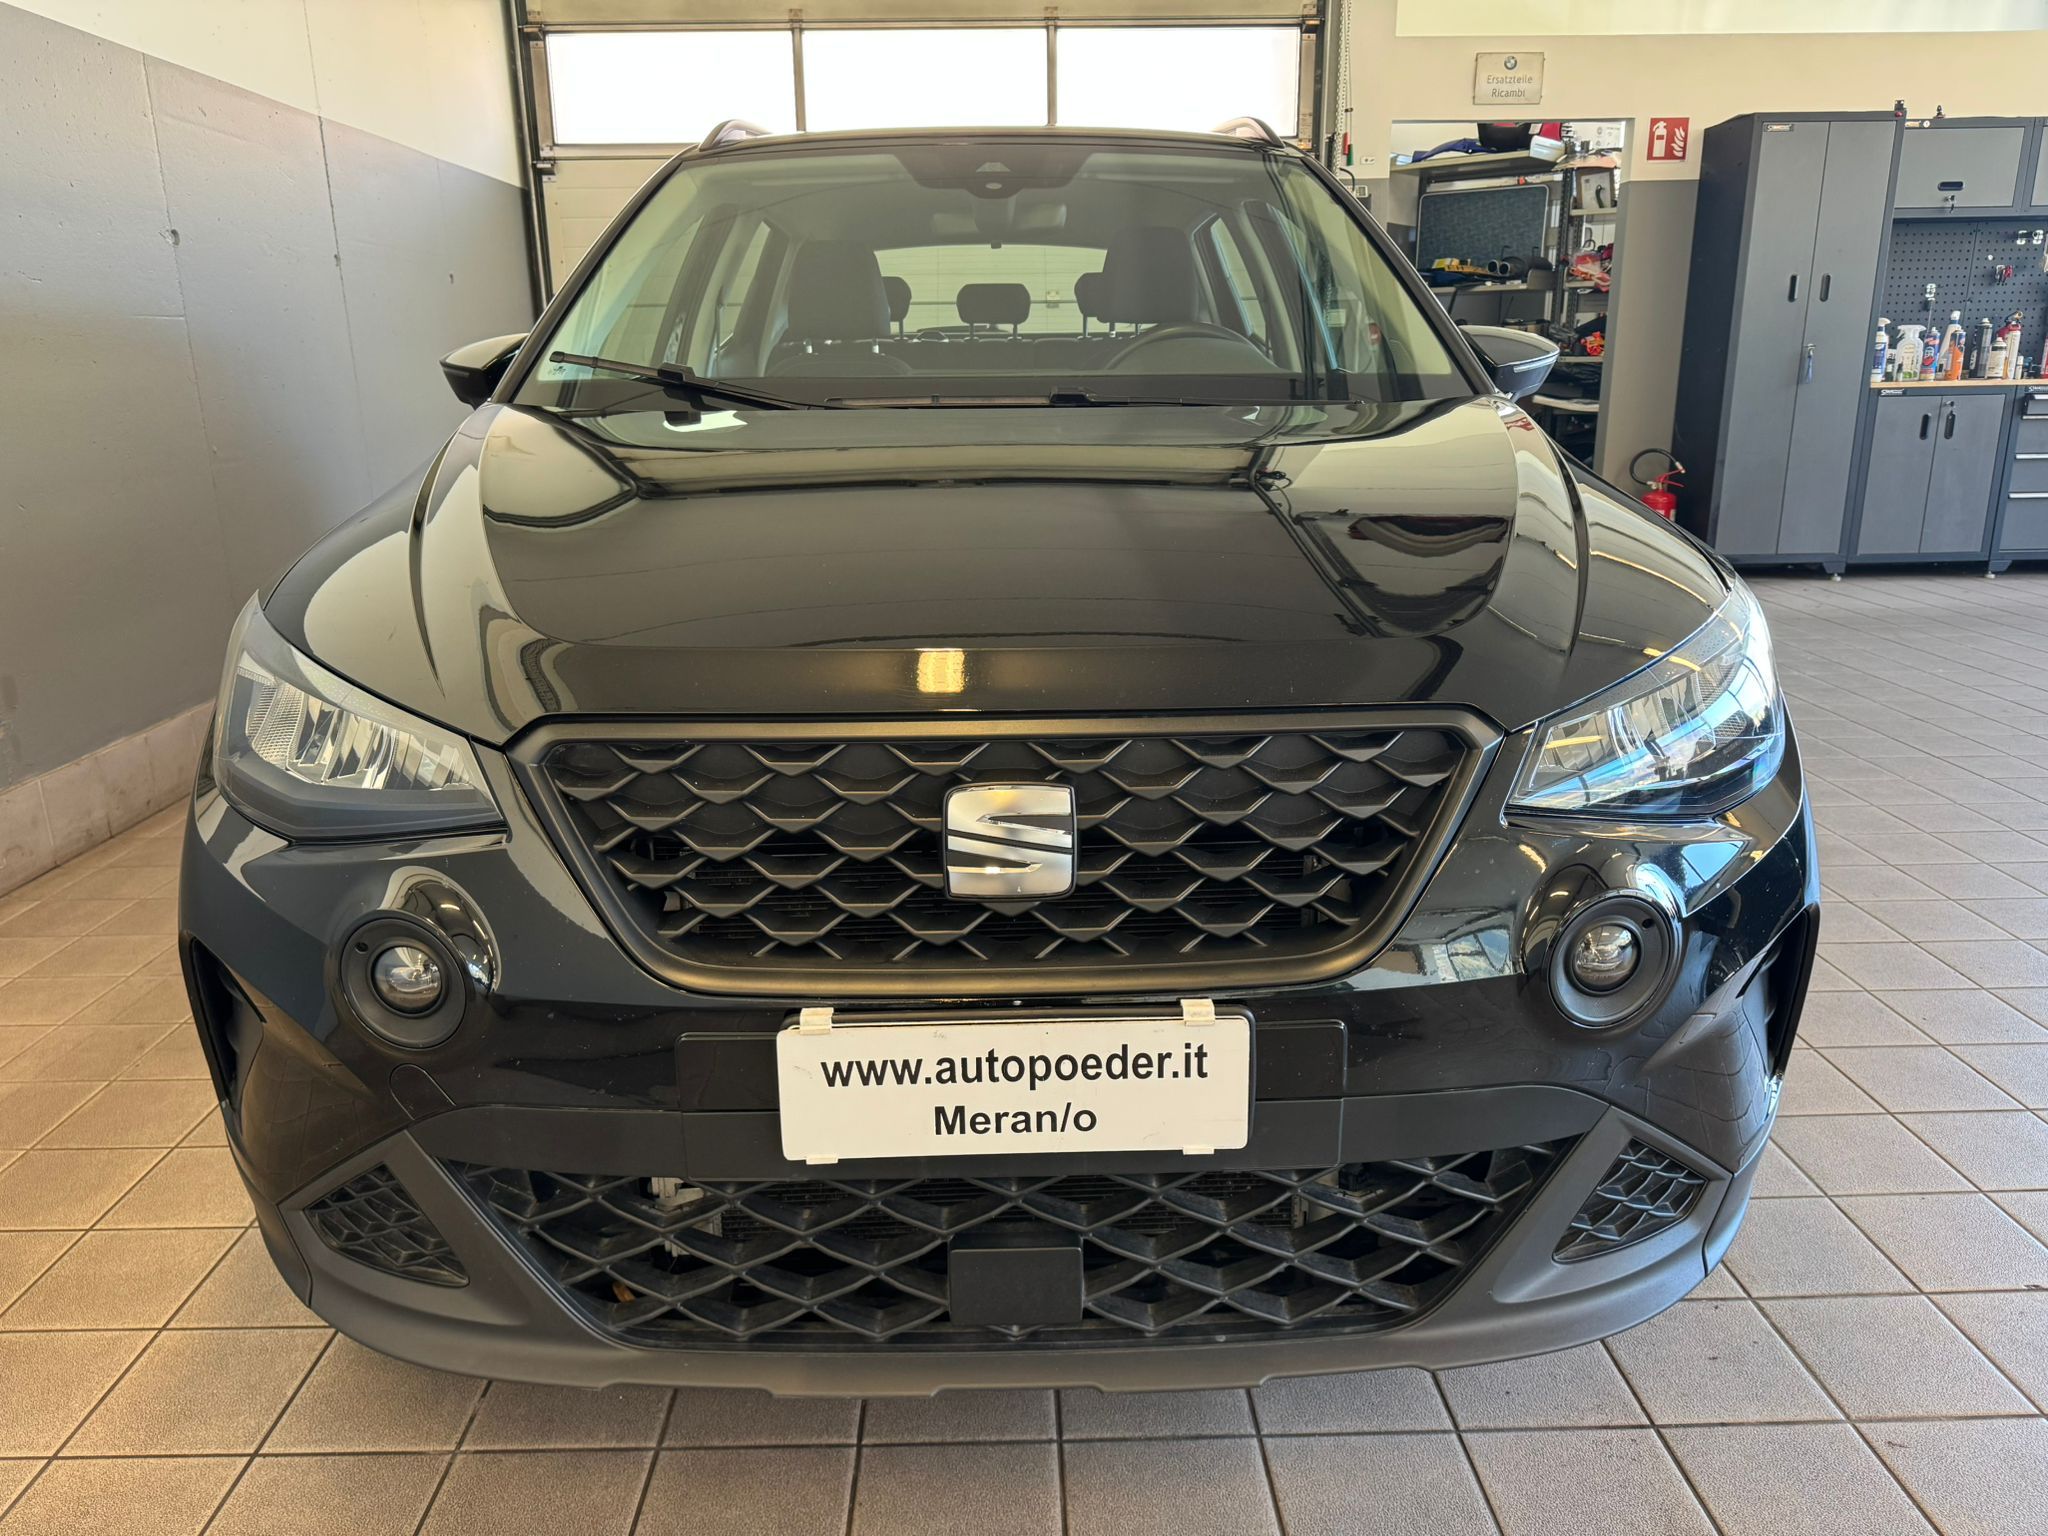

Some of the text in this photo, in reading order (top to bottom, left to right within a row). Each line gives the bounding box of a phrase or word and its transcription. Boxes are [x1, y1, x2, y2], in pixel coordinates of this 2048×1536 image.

[1486, 74, 1533, 85] Ersatzteile
[1491, 88, 1526, 98] Ricambi
[820, 1042, 1209, 1091] www.autopoeder.it
[934, 1102, 1098, 1136] Meran/o
